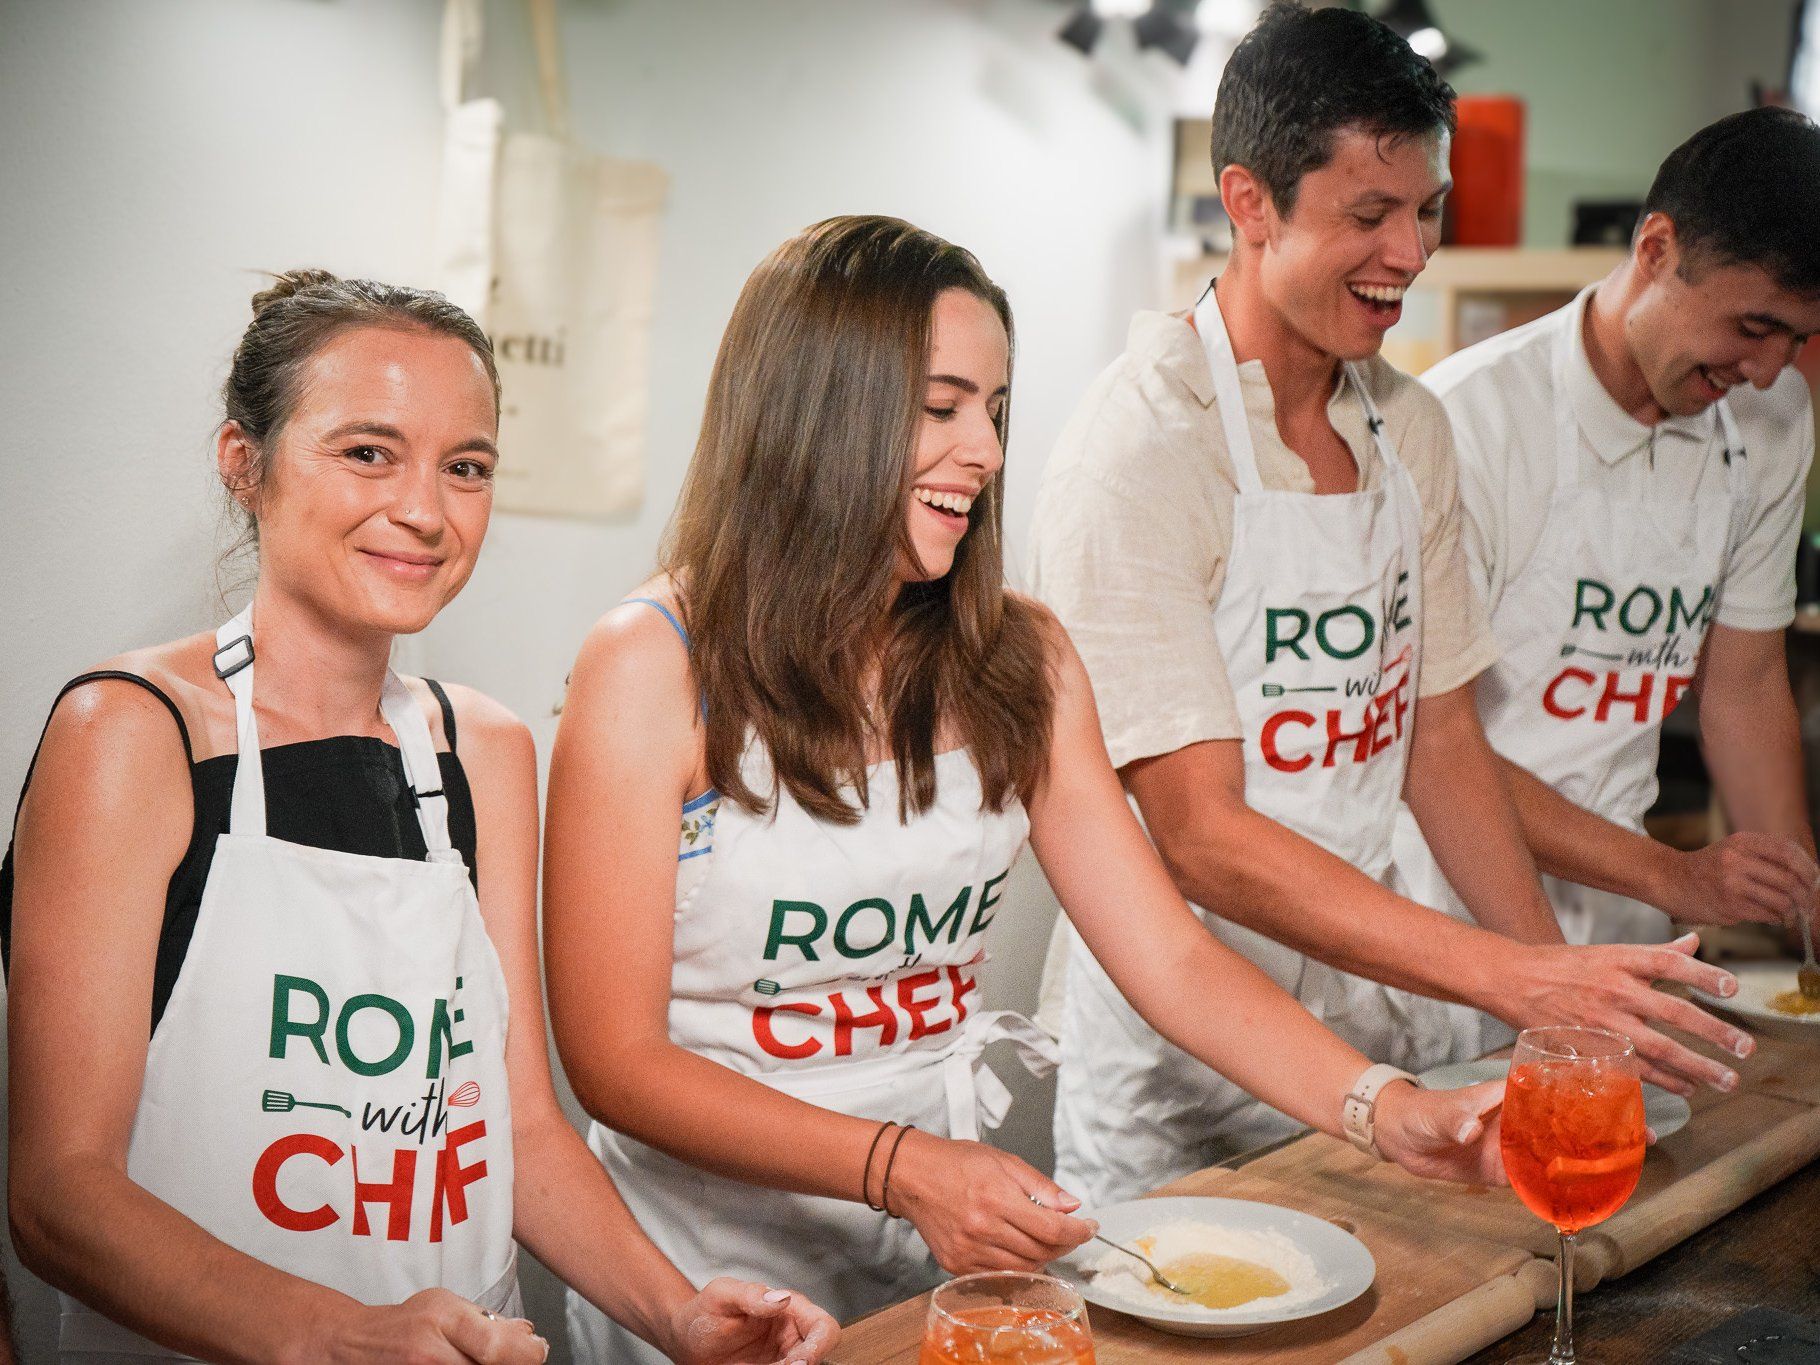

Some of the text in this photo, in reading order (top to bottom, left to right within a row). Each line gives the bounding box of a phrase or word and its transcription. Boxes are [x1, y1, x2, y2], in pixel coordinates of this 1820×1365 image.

[1265, 570, 1412, 664] ROE
[1571, 577, 1712, 636] ROM
[762, 868, 1009, 962] ROME
[752, 948, 986, 1060] CHEF
[361, 1076, 449, 1145] with
